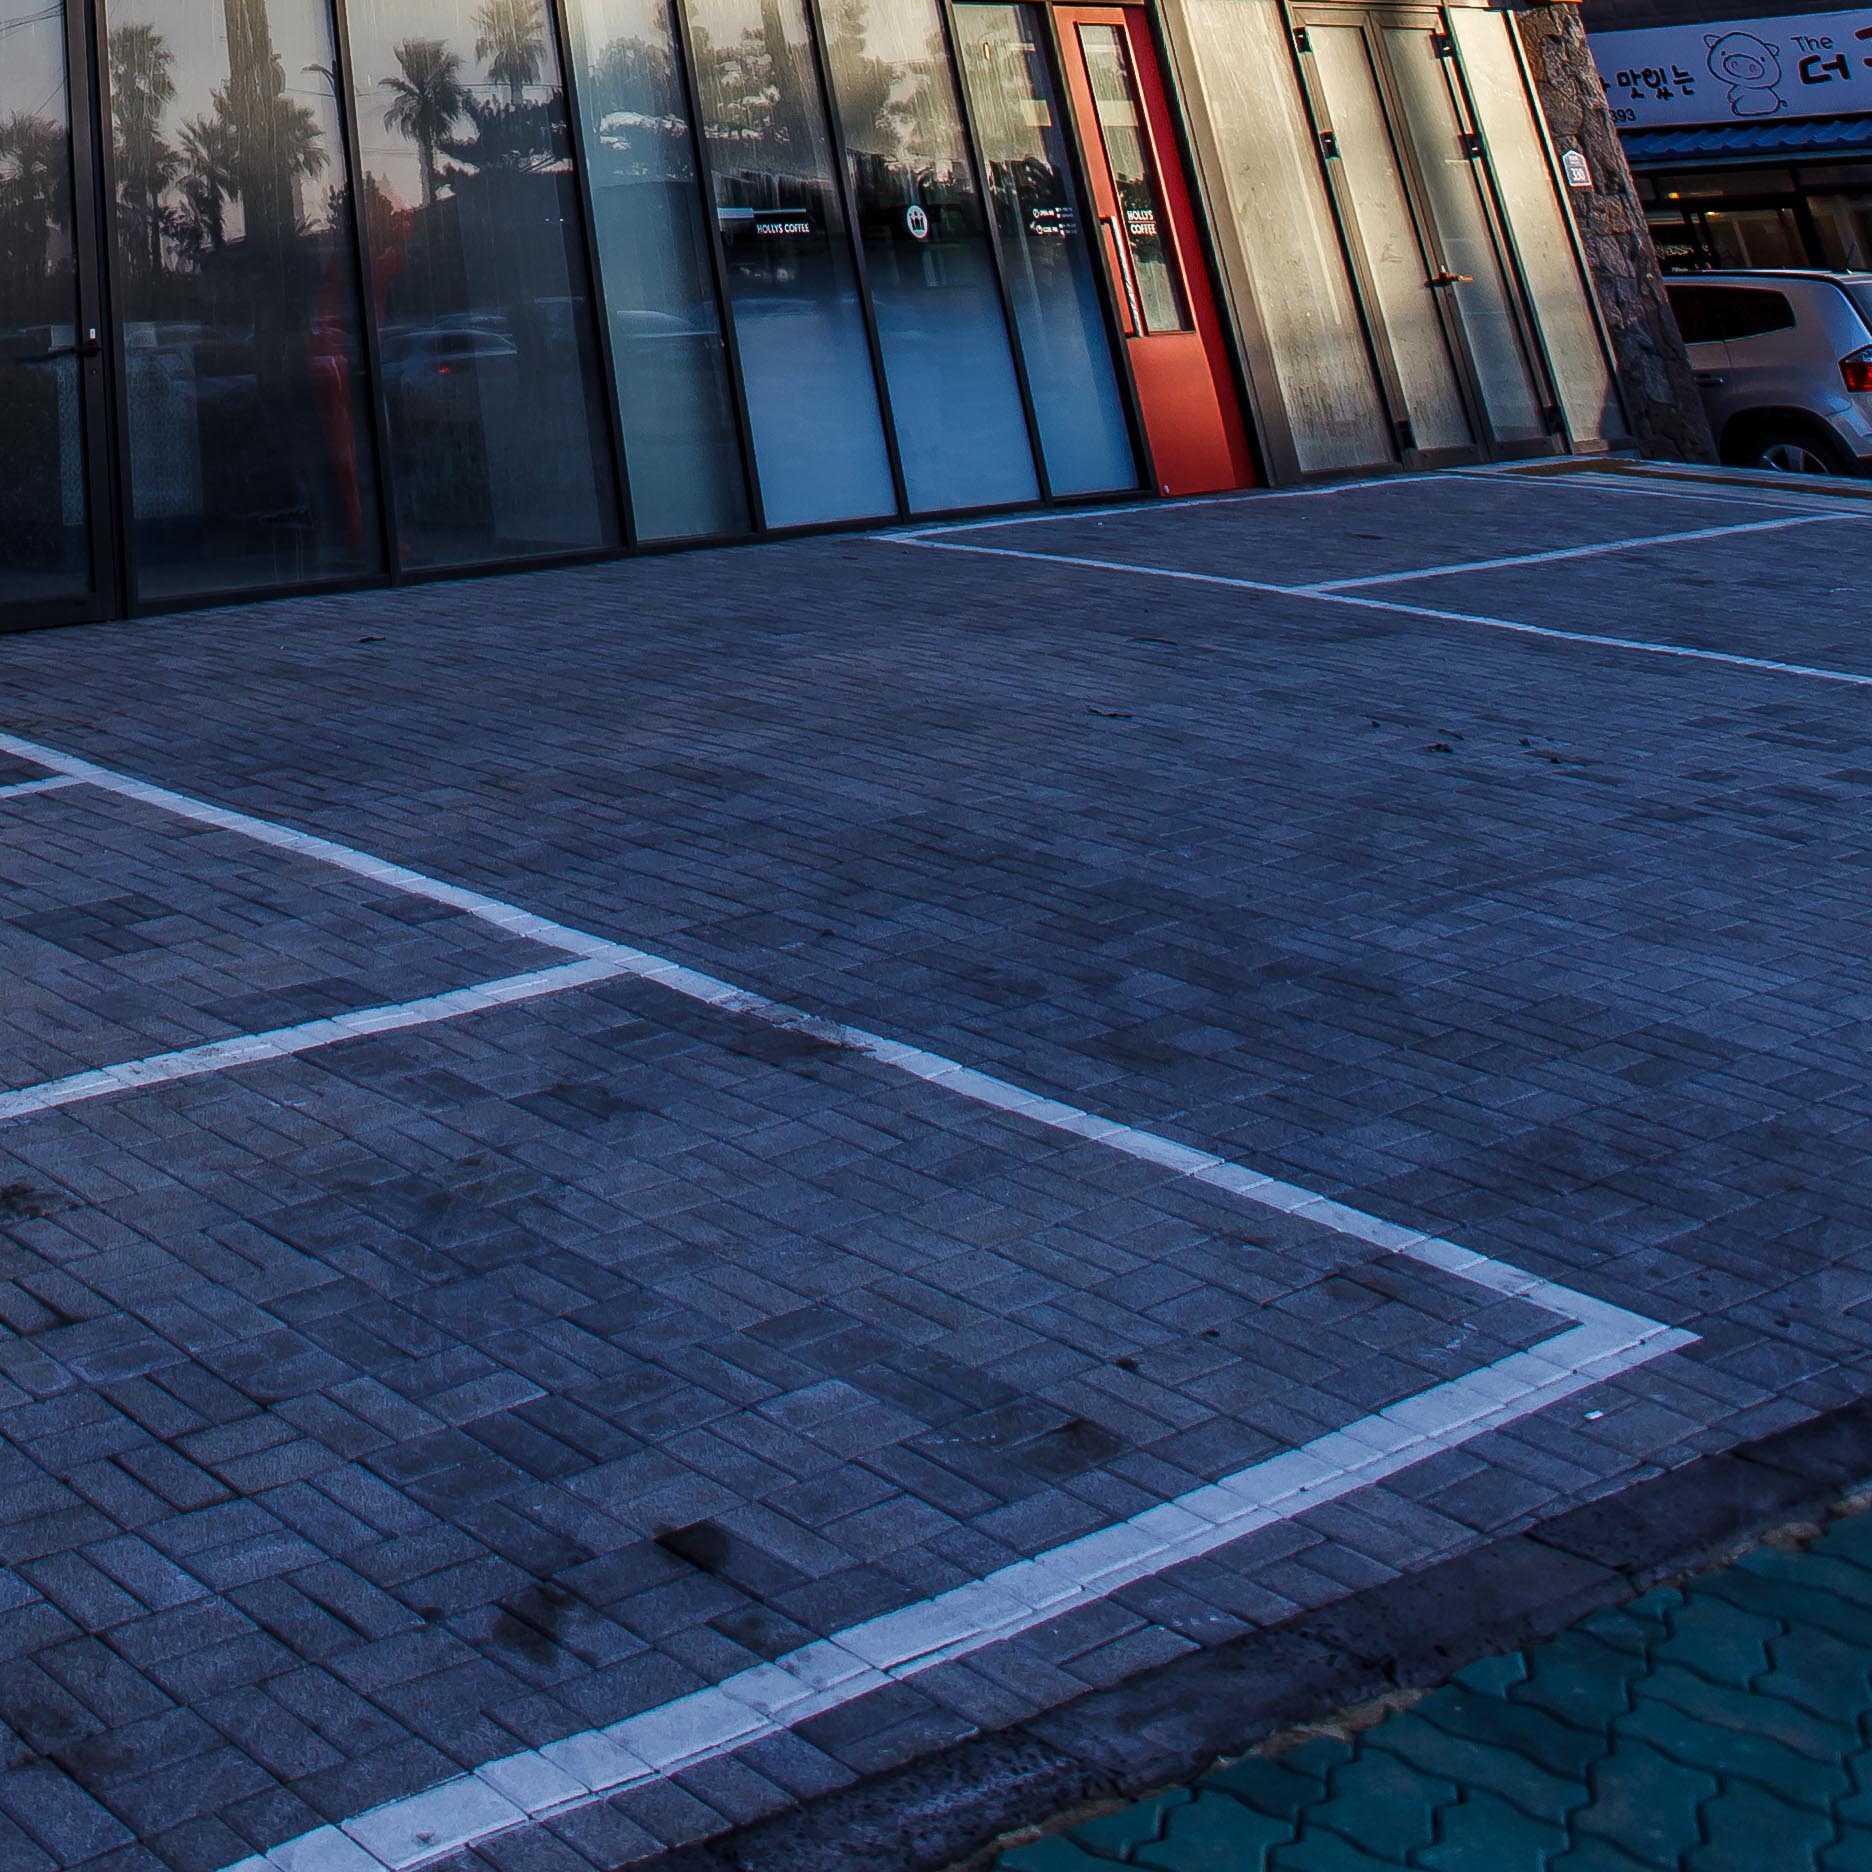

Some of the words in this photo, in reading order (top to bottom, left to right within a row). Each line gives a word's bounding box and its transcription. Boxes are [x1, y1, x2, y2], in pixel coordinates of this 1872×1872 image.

[1791, 34, 1834, 53] The
[1616, 64, 1695, 101] 맛있는
[1798, 52, 1852, 85] 더
[1126, 209, 1154, 221] HOLLYS
[756, 223, 784, 234] HOLLYS
[784, 222, 810, 233] COFFEE
[1130, 223, 1157, 235] COFFEE
